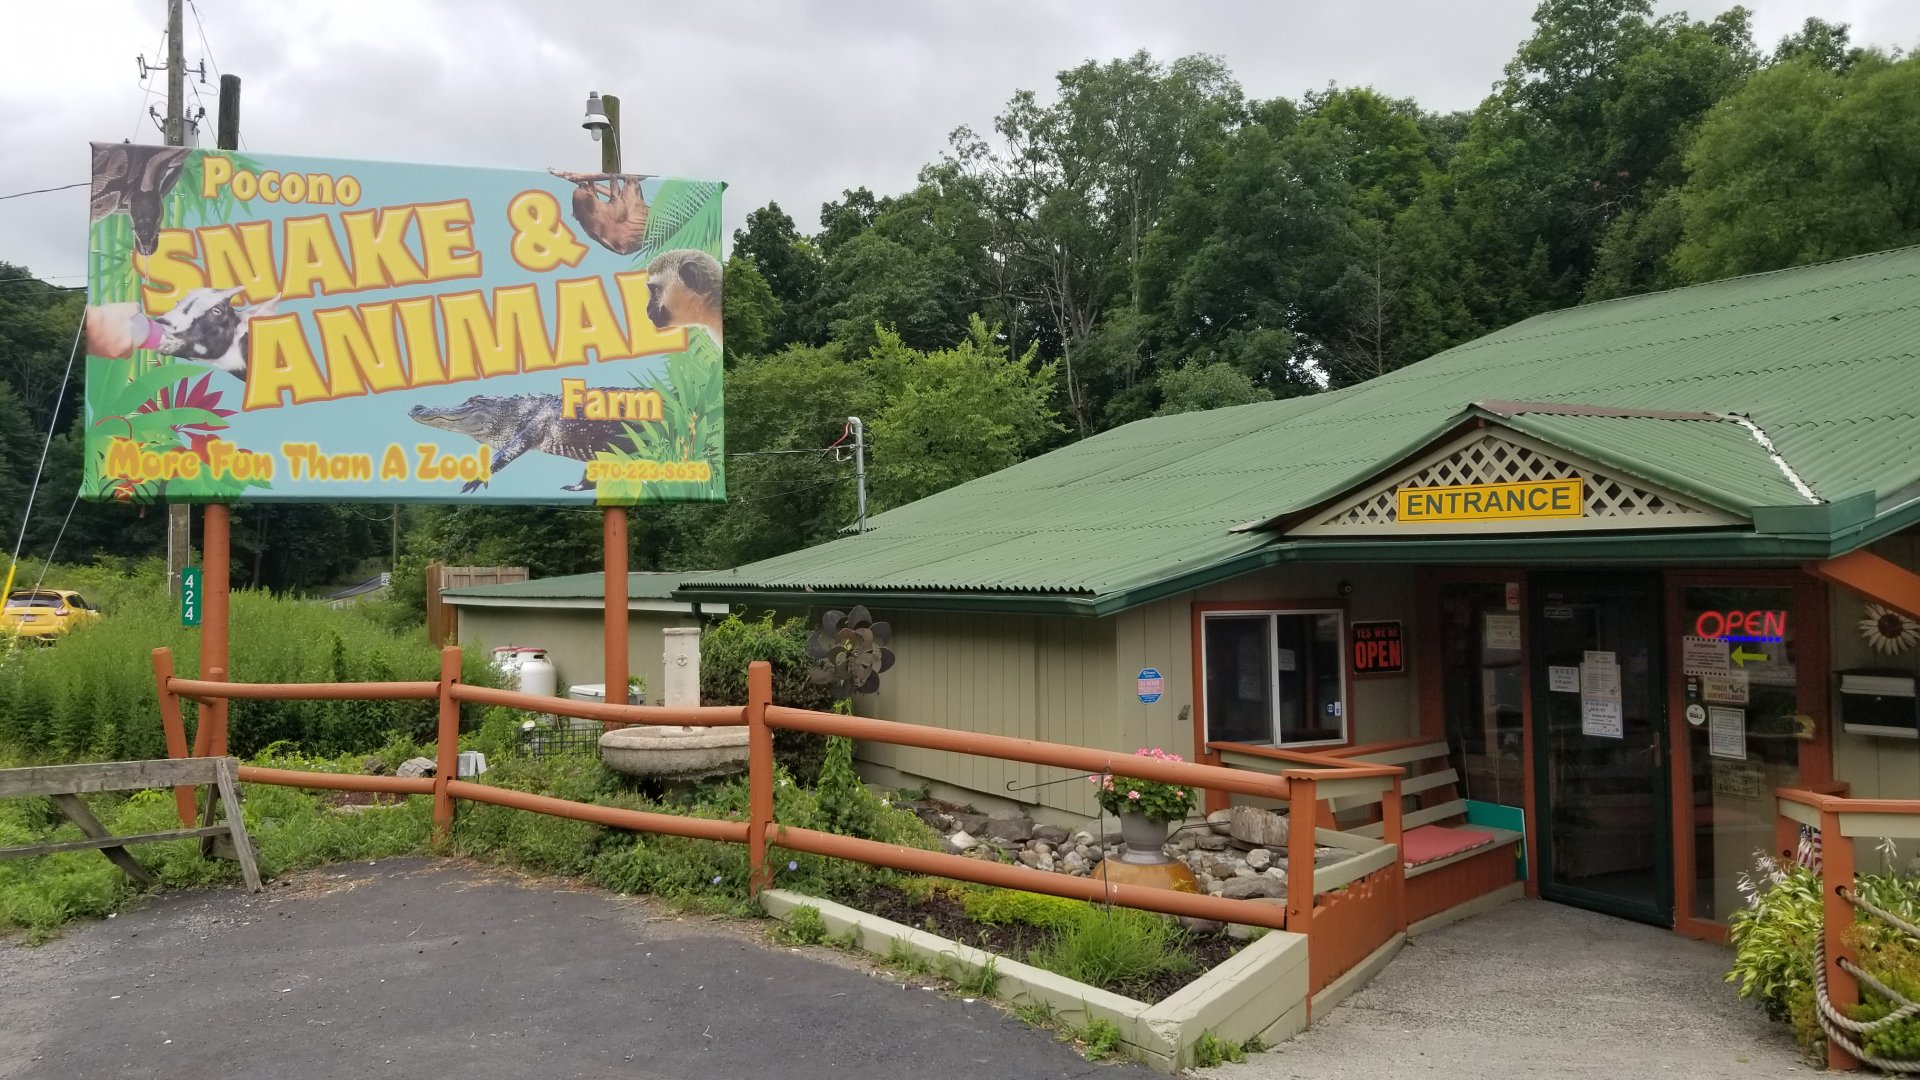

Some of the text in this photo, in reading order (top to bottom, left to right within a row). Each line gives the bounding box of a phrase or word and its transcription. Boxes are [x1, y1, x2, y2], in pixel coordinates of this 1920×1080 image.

[202, 156, 361, 206] Pocono
[133, 189, 590, 315] SNAKE &
[242, 269, 689, 411] ANIMAL
[561, 378, 664, 421] Farm
[105, 438, 493, 483] More Fun Than A Zoo!
[586, 459, 712, 483] 570-223-8653
[1407, 486, 1571, 516] ENTRANCE
[184, 573, 194, 621] 424
[1356, 627, 1372, 639] YES
[1696, 610, 1787, 639] OPEN
[1355, 640, 1401, 669] OPEN
